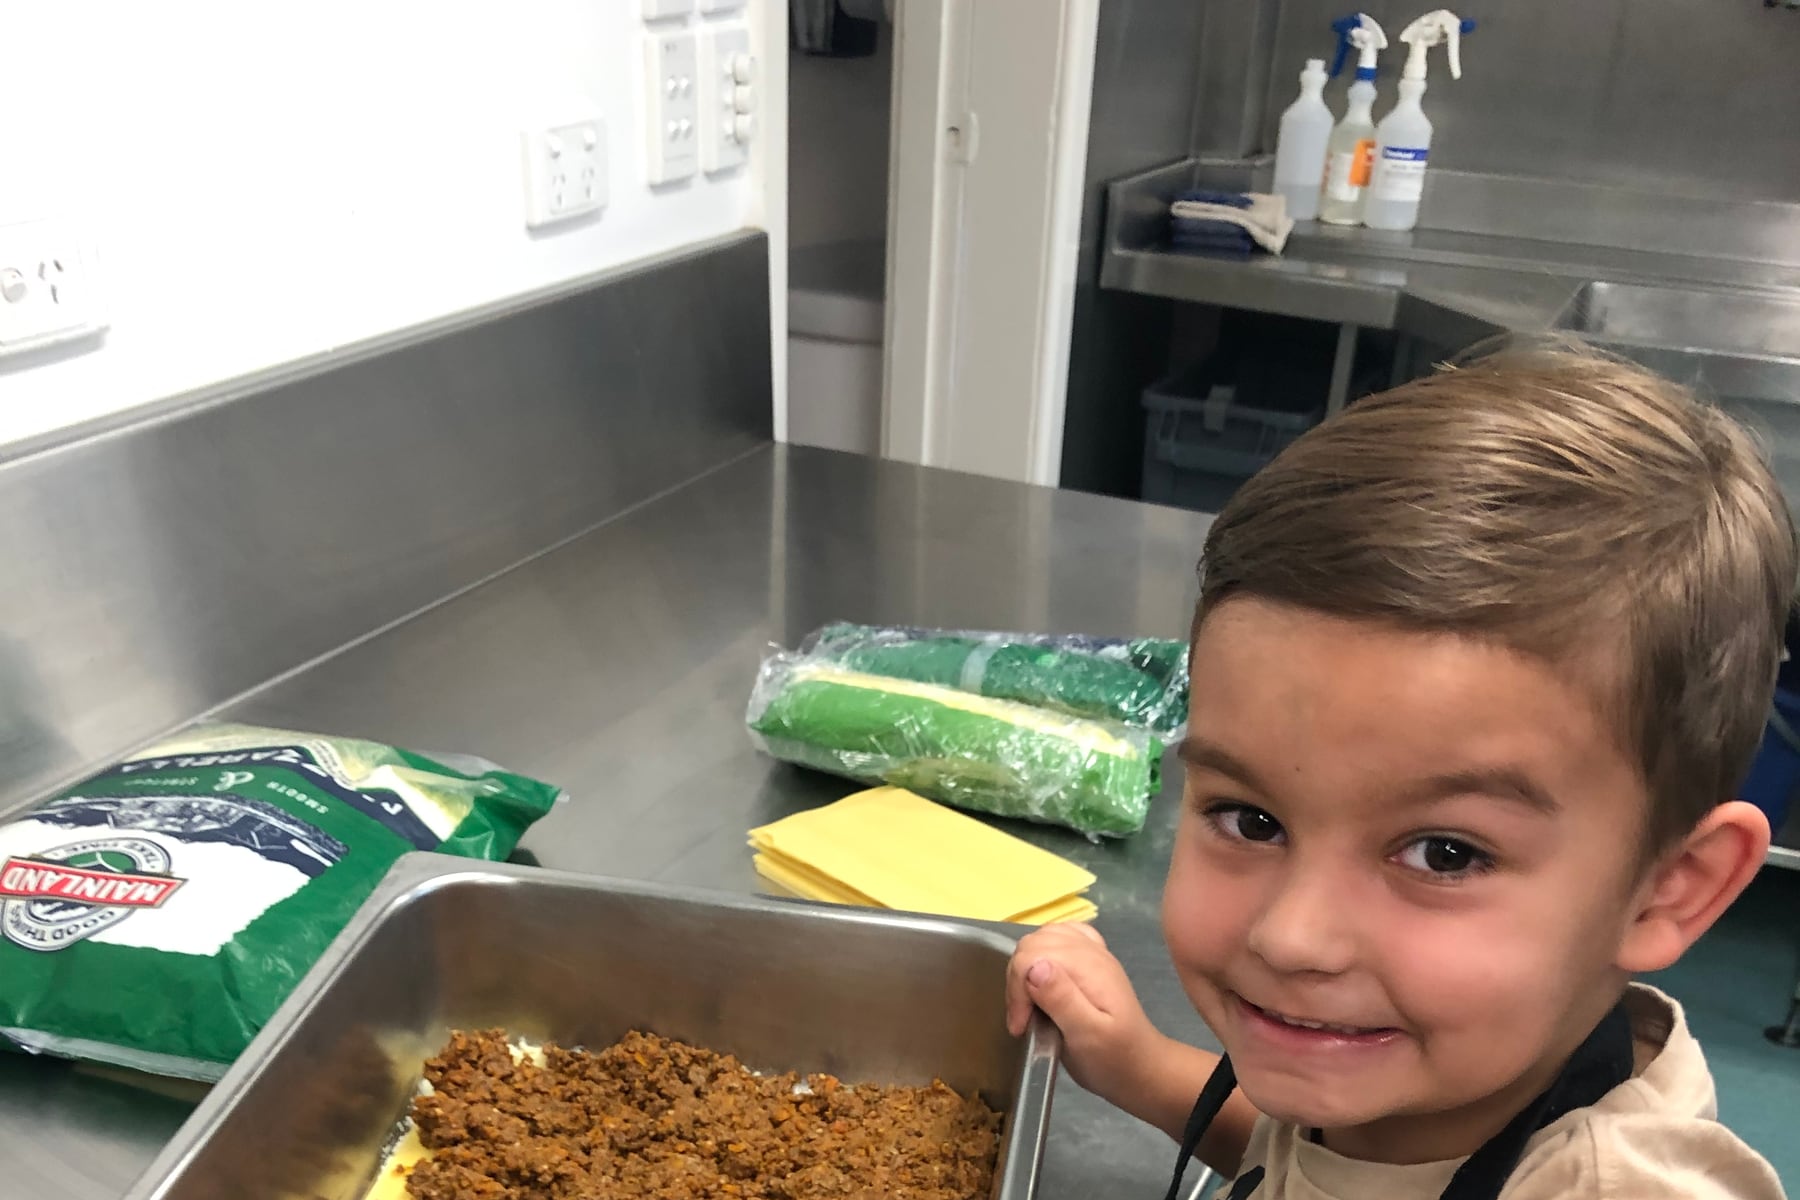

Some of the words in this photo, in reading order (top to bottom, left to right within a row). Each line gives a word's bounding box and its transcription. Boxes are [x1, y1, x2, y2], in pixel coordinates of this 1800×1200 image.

[266, 780, 329, 814] SMOOTH
[2, 866, 166, 902] MAINLAND
[52, 910, 115, 940] GOOD
